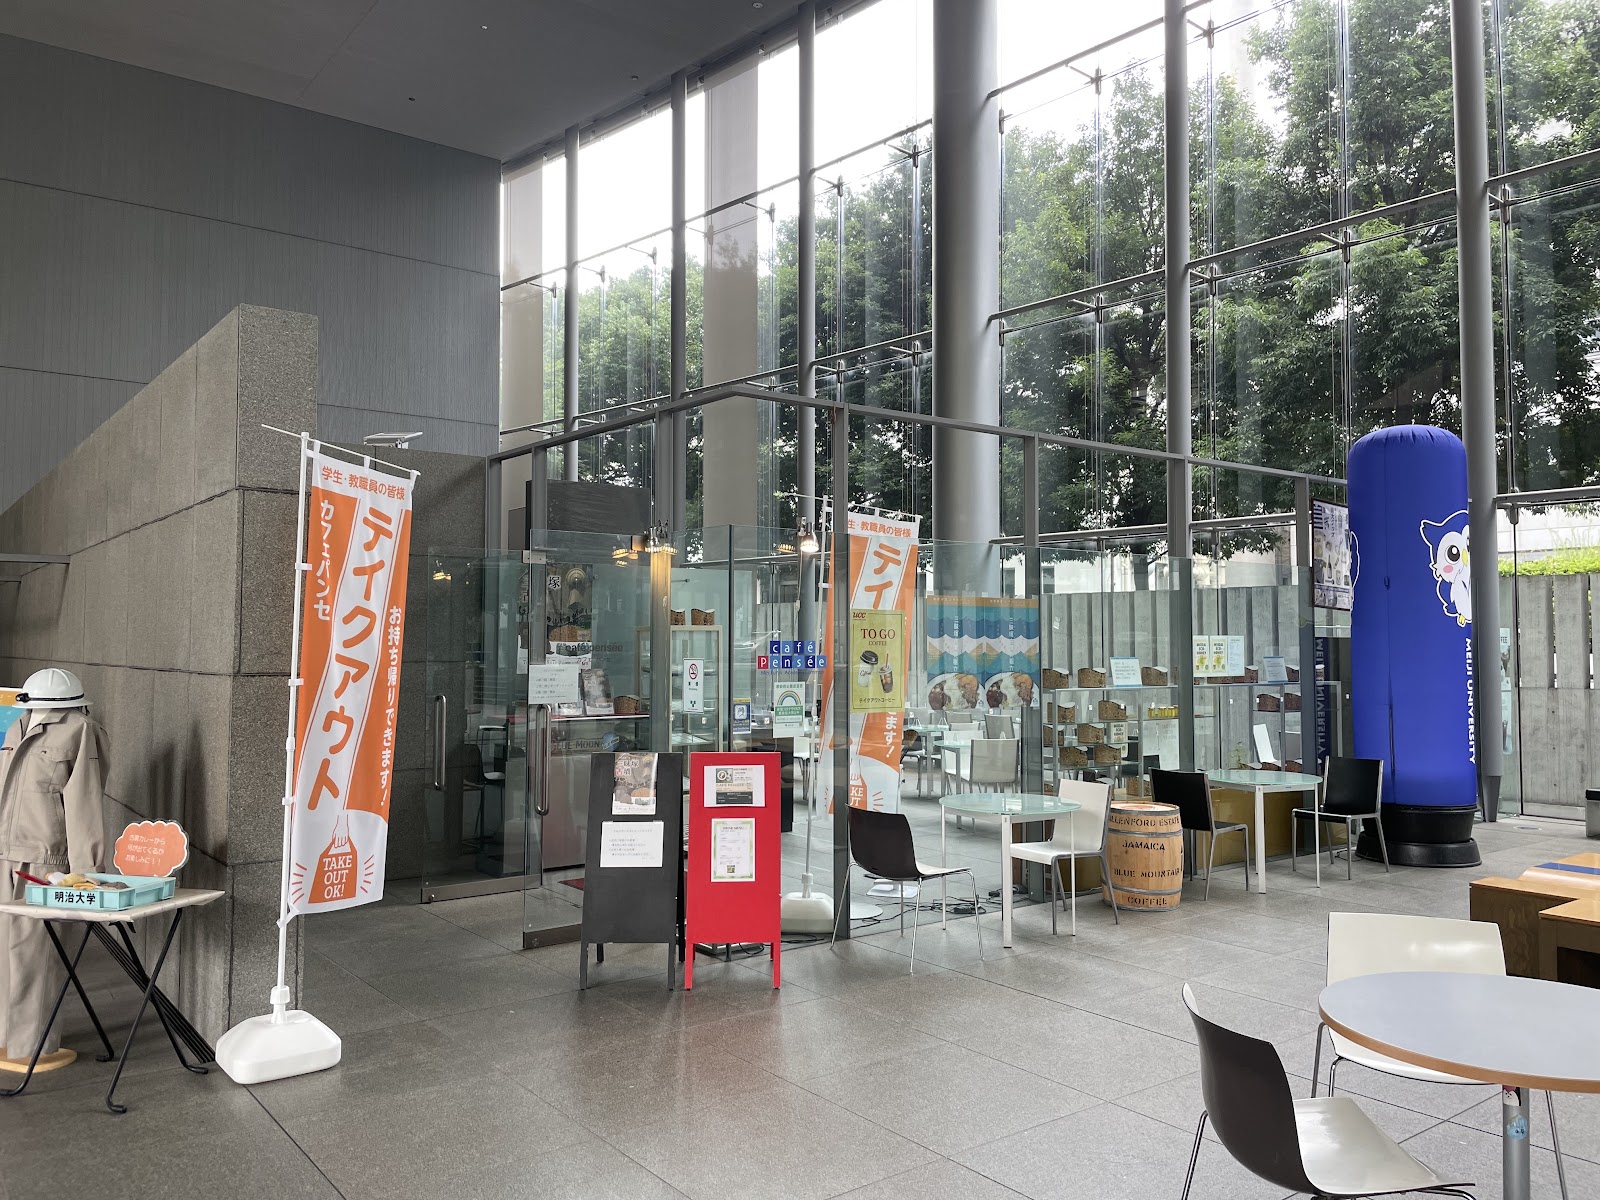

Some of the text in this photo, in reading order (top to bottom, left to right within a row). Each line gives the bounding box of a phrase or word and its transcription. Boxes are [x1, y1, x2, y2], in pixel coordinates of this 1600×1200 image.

[321, 465, 406, 501] 学生・教職員の皆様
[848, 519, 911, 538] 生・教職員の皆様
[313, 499, 335, 622] カフェパンセ
[863, 542, 902, 609] テイ
[860, 628, 896, 640] TO GO
[772, 641, 814, 653] café
[307, 506, 393, 811] テイクアウト
[760, 655, 825, 668] Pensée
[1465, 637, 1476, 765] MEIJI UNIVERSITY
[882, 713, 898, 759] ます！
[575, 740, 600, 749] MOON
[1158, 816, 1181, 827] ESTATE
[1122, 839, 1166, 851] JAMAICA
[322, 854, 353, 871] TAKE
[323, 871, 349, 886] OUT
[1114, 868, 1136, 878] BLUE
[54, 891, 96, 905] 明治大学
[323, 883, 346, 900] OK!
[1126, 895, 1168, 906] COFFEE
